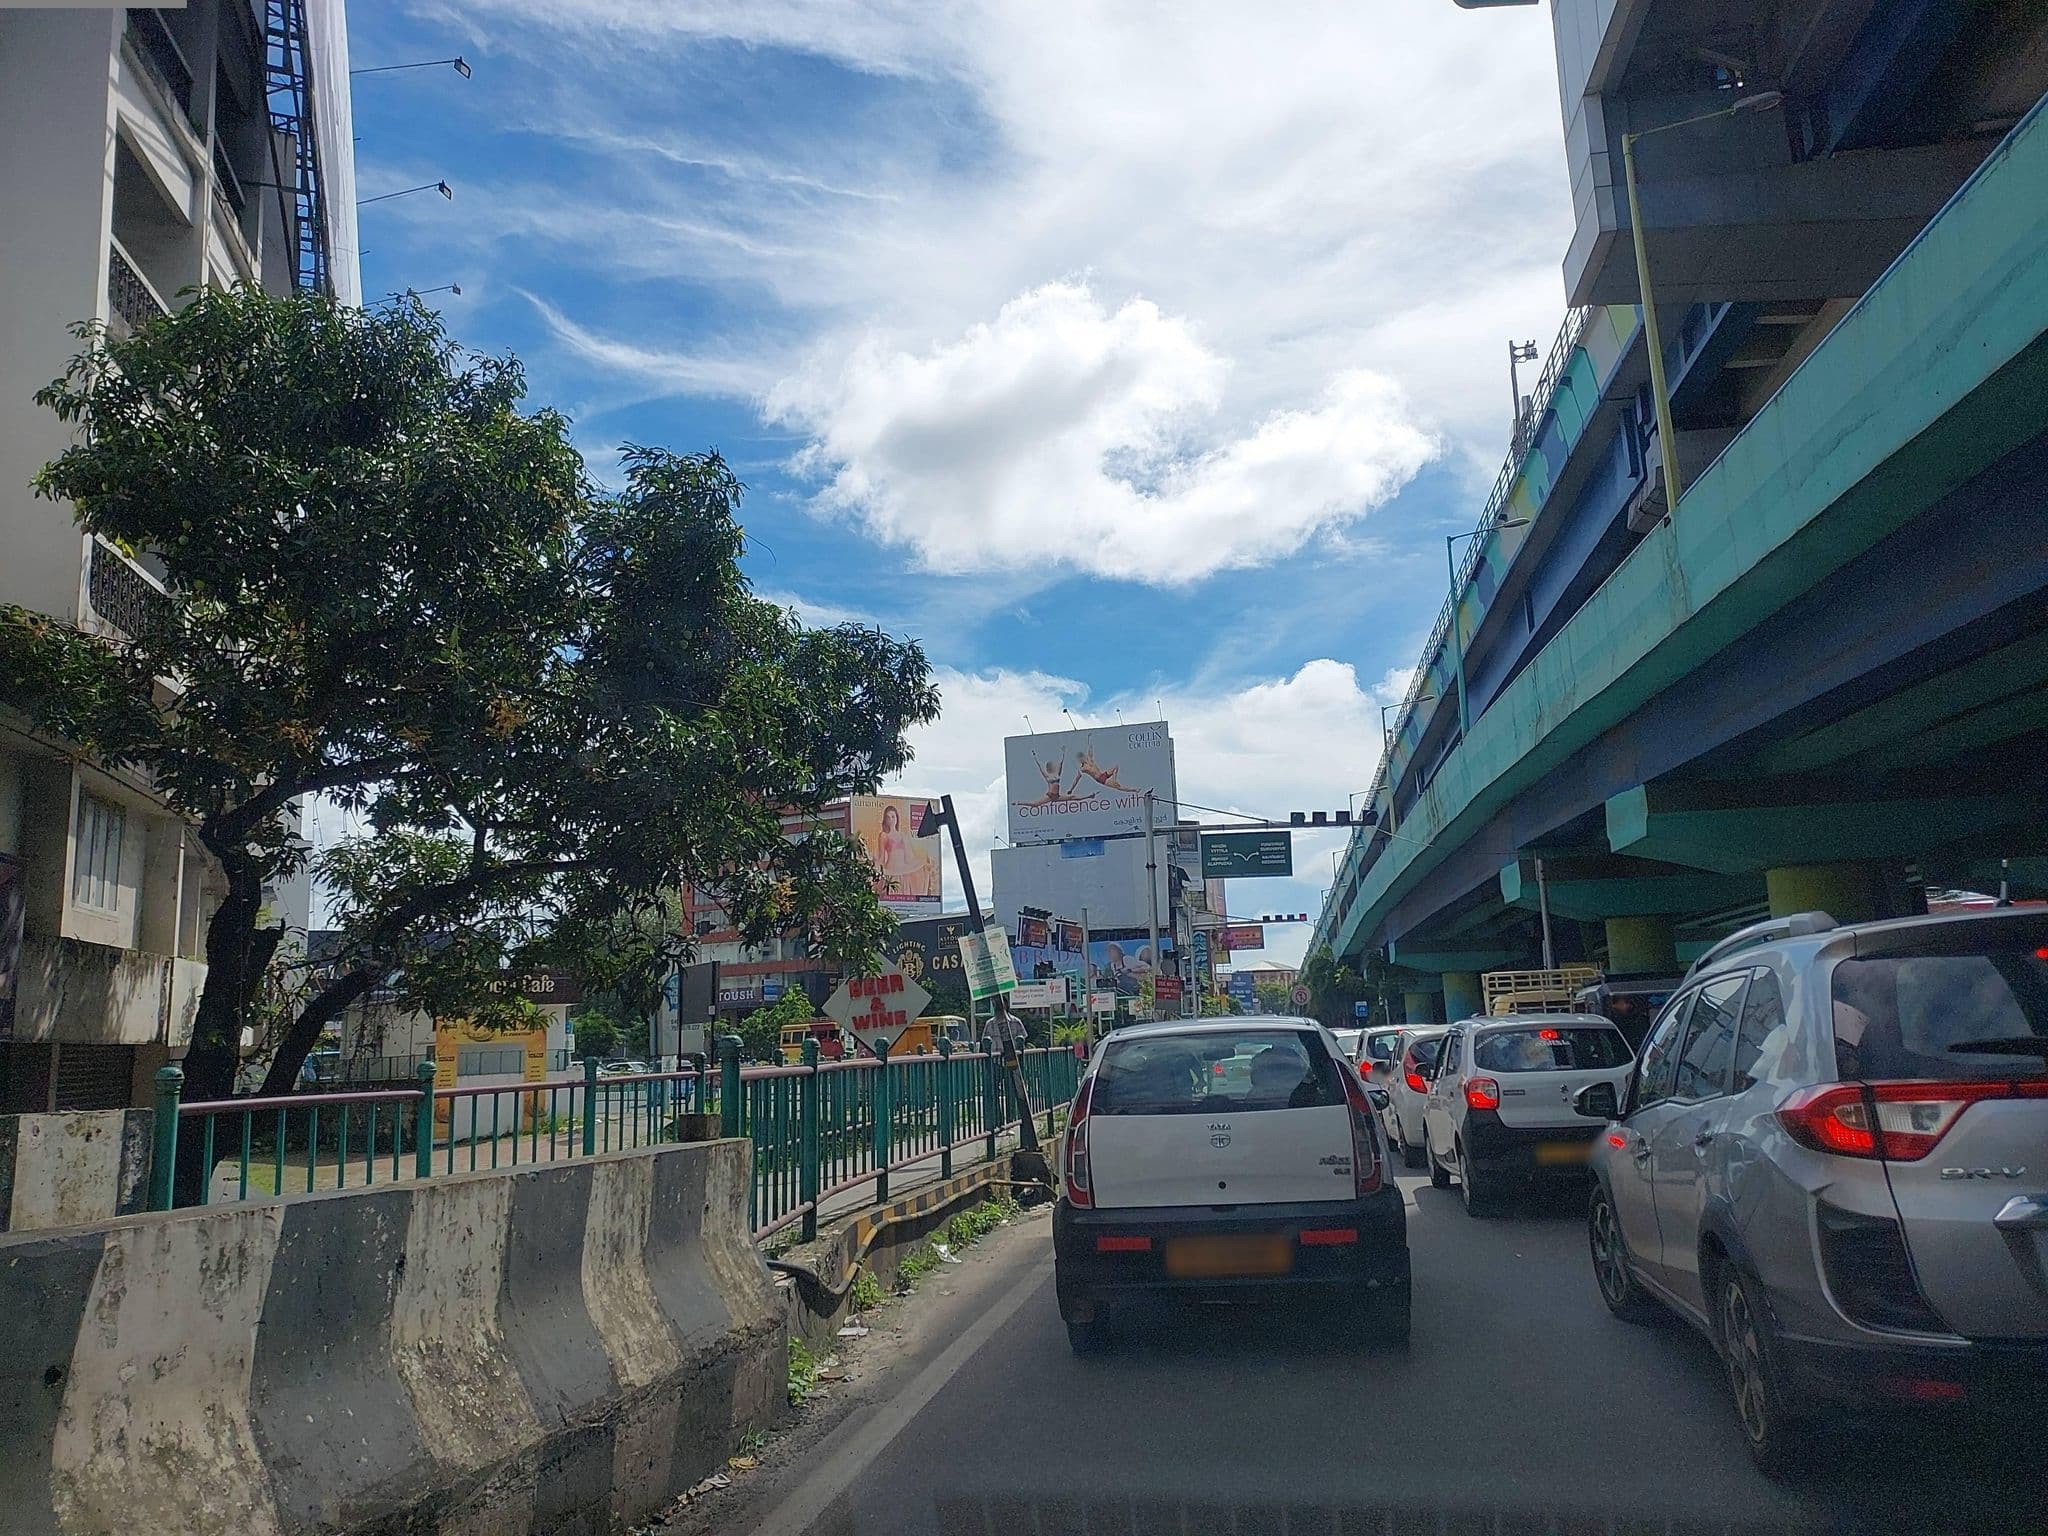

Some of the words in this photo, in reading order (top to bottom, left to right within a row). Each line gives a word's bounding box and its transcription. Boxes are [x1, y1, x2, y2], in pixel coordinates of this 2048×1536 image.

[1019, 798, 1111, 818] confidence
[1115, 793, 1160, 809] withn
[892, 940, 927, 954] LIGHTING
[848, 974, 904, 998] BEER
[852, 1010, 908, 1030] WINE
